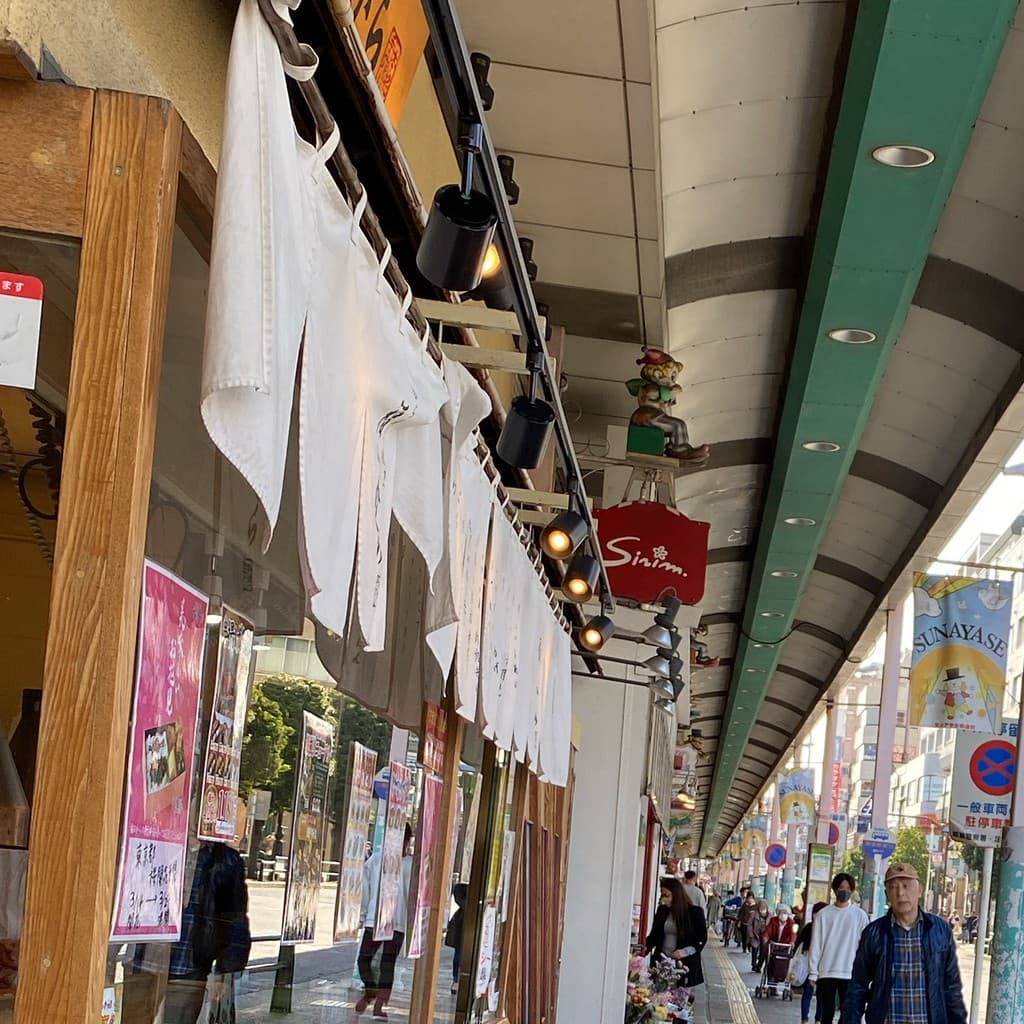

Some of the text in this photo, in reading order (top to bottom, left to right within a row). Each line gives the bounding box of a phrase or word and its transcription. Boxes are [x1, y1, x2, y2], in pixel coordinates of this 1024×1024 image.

[2, 280, 25, 293] ます
[914, 622, 1008, 658] SUNAYASE
[957, 802, 1009, 816] 一般車両
